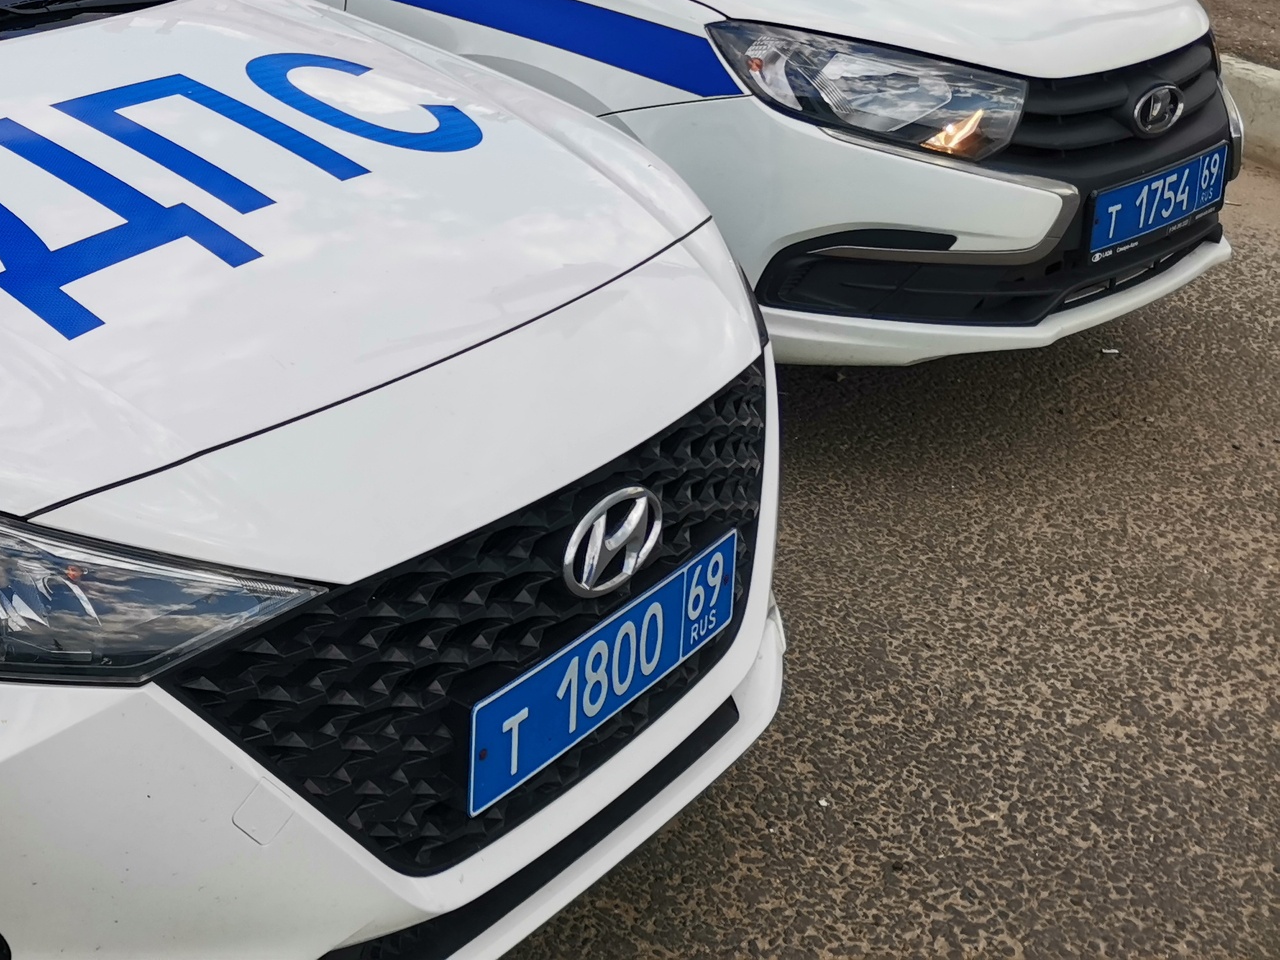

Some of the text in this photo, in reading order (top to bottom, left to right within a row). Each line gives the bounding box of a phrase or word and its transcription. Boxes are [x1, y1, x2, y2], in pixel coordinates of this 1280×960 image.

[1107, 203, 1122, 239] Т
[1135, 168, 1190, 229] 1754
[1201, 153, 1220, 190] 69
[502, 551, 724, 776] Т 1800 69
[690, 609, 717, 645] RUS
